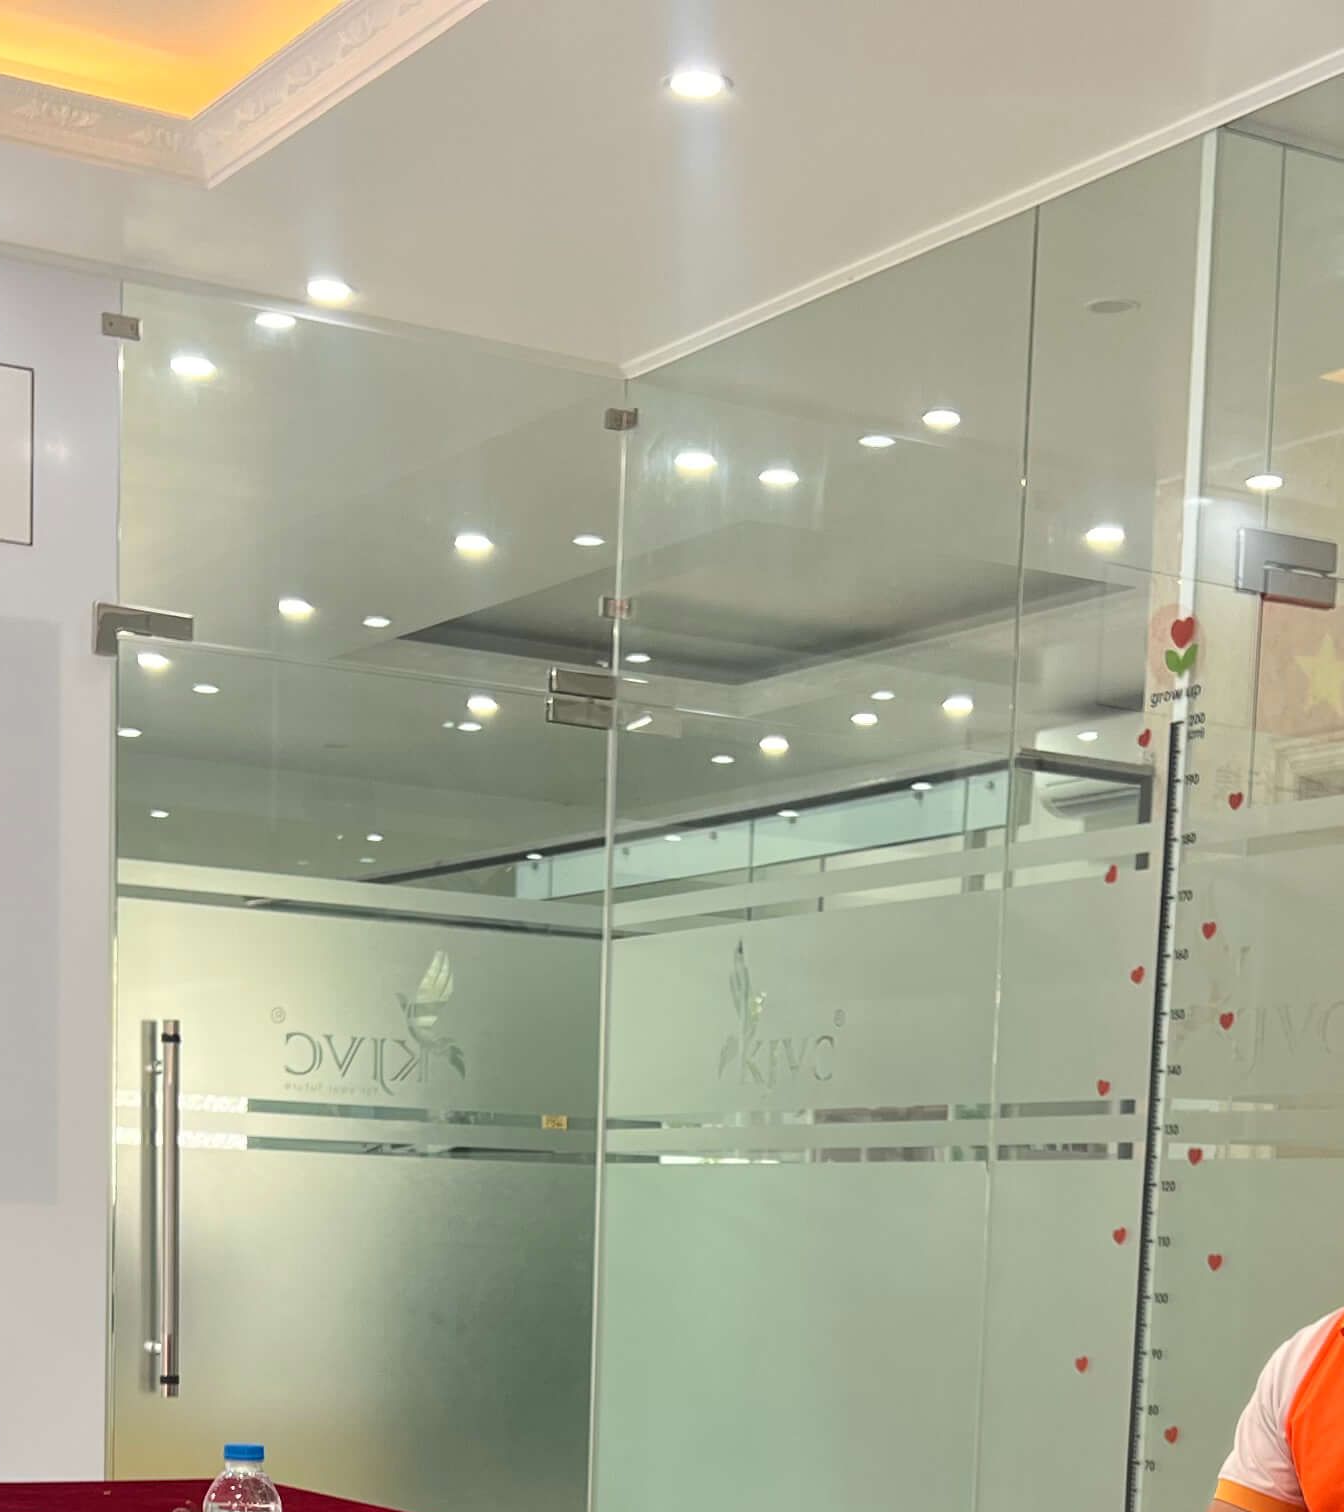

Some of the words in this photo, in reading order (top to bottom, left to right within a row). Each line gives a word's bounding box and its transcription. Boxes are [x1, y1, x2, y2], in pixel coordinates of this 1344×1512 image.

[1186, 684, 1201, 699] up
[1188, 713, 1206, 725] 200
[1161, 1181, 1176, 1192] 120
[1154, 1292, 1168, 1304] 100
[1148, 1404, 1159, 1416] 80
[1145, 1460, 1155, 1471] 70
